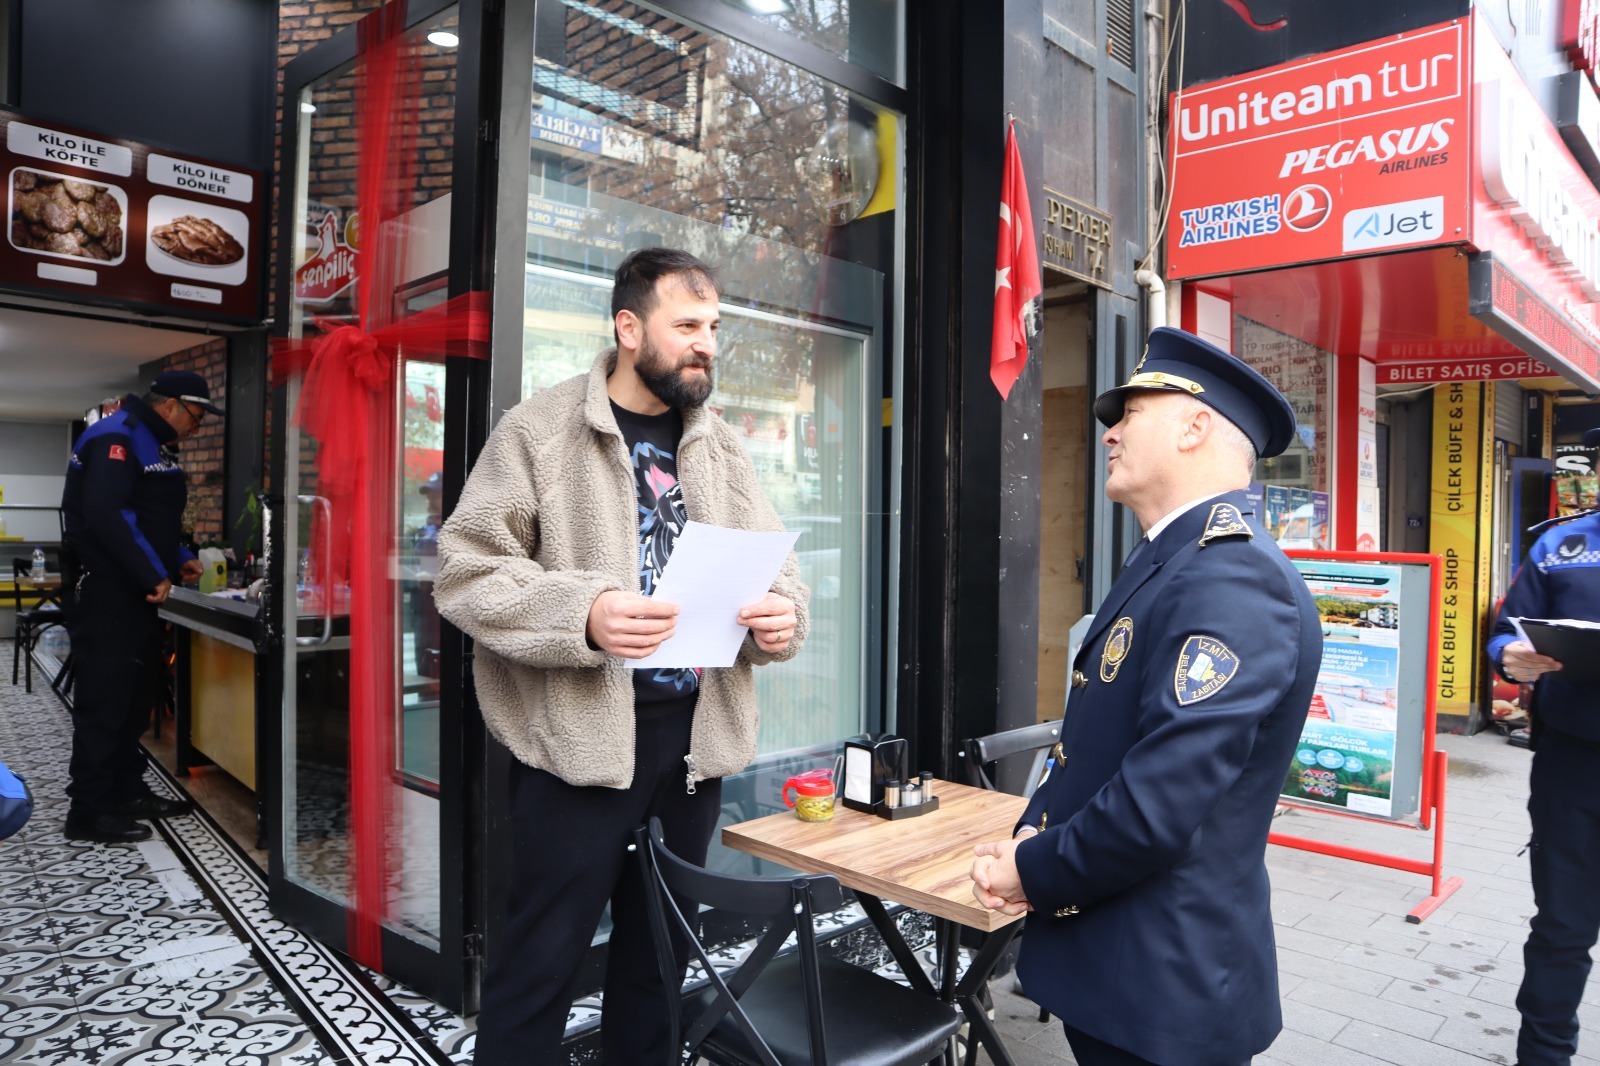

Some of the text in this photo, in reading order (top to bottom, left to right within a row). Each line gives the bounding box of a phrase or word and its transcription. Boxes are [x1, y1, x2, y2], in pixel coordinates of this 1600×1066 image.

[1181, 54, 1454, 141] Uniteam tur
[38, 133, 106, 156] KİLO İLE
[45, 147, 99, 167] KÖFTE
[1278, 118, 1455, 179] PEGASUS
[172, 163, 231, 184] KİLO İLE
[1379, 152, 1449, 175] AIRLINES
[176, 176, 226, 194] DÖNER
[1044, 198, 1111, 247] PEKER
[1182, 195, 1279, 227] TURKISH
[1181, 215, 1280, 246] AIRLINES
[1390, 365, 1435, 381] BİLET
[1440, 363, 1492, 379] SATIŞ
[1449, 406, 1464, 419] &
[1445, 422, 1463, 464] BÜFE
[1445, 468, 1464, 513] ÇİLEK
[1438, 548, 1459, 699] ÇİLEK BÜFE & SHOP
